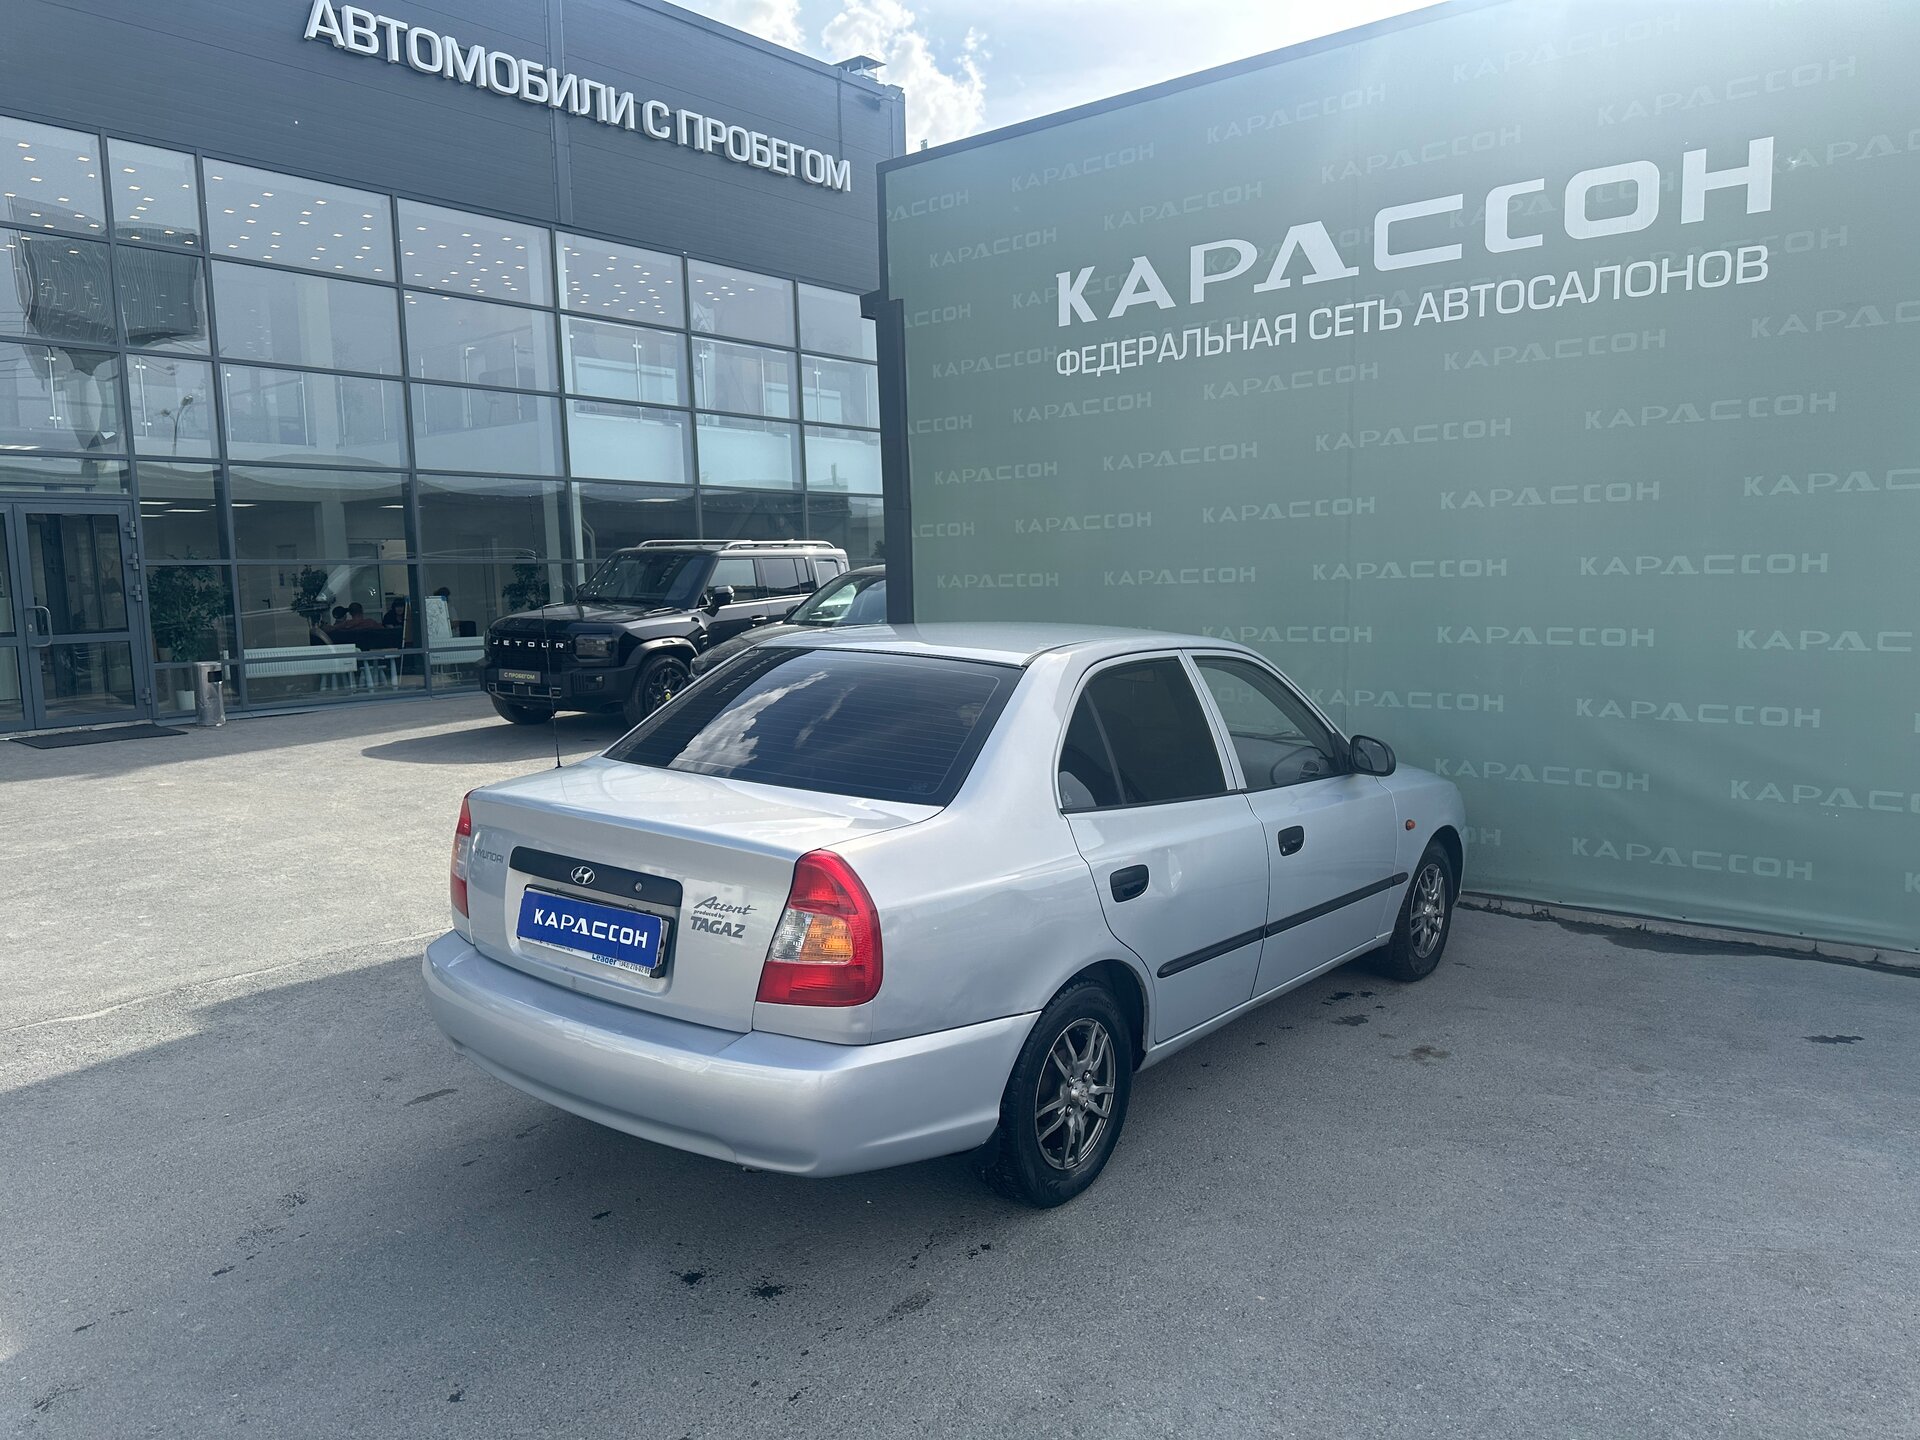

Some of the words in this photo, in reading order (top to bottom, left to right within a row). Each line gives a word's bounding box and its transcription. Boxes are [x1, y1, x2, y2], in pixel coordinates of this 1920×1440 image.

[304, 0, 635, 130] АВТОМОБИЛИ
[642, 100, 670, 140] С
[677, 109, 851, 192] ПРОБЕГОМ
[1056, 312, 1297, 377] ФЕДЕРАЛЬНАЯ
[1308, 298, 1404, 341] СЕТЬ
[1413, 244, 1769, 326] АВТОСАЛОНОВ
[493, 639, 564, 649] JETOUR
[508, 672, 535, 680] ПРОБЕГОМ
[693, 895, 757, 915] Accent
[693, 910, 718, 918] produced
[690, 915, 746, 938] TAGAZ
